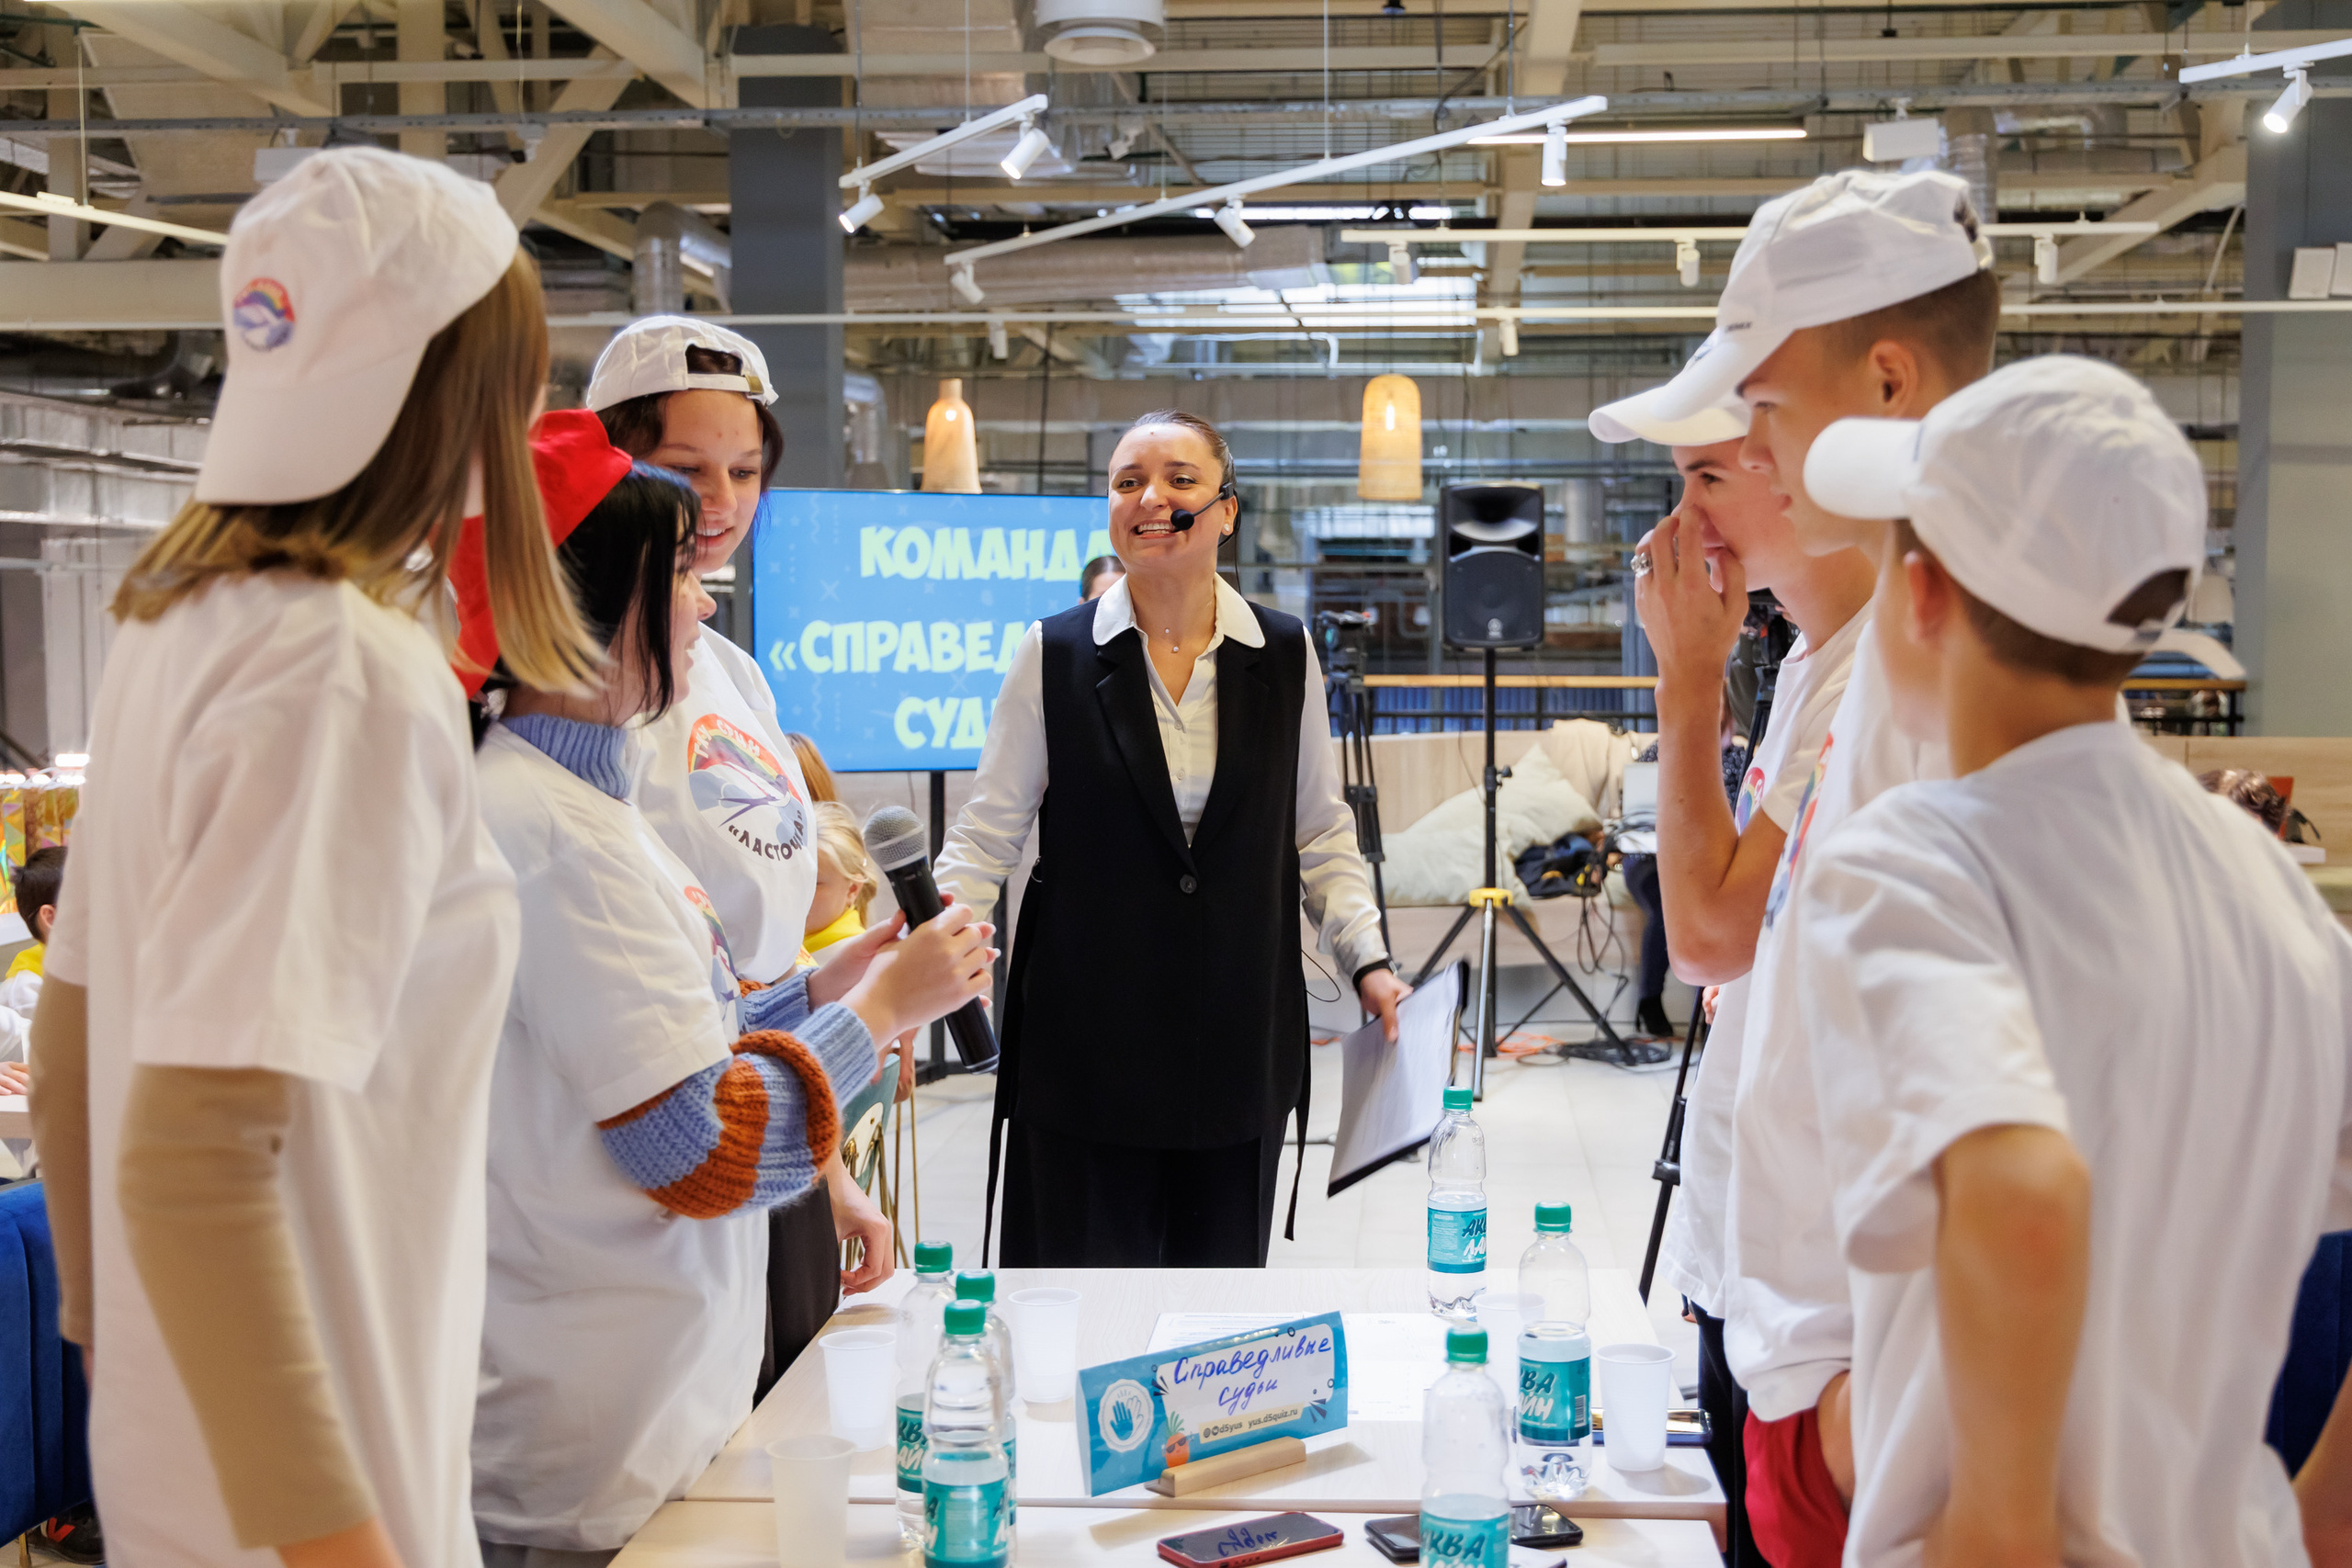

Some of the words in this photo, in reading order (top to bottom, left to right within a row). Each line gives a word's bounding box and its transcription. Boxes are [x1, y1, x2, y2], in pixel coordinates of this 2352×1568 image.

[894, 695, 997, 750] СУД
[1174, 1335, 1331, 1390] Справедливые
[1521, 1367, 1556, 1394] ВА
[1248, 1408, 1298, 1428] yus.d5quiz.ru
